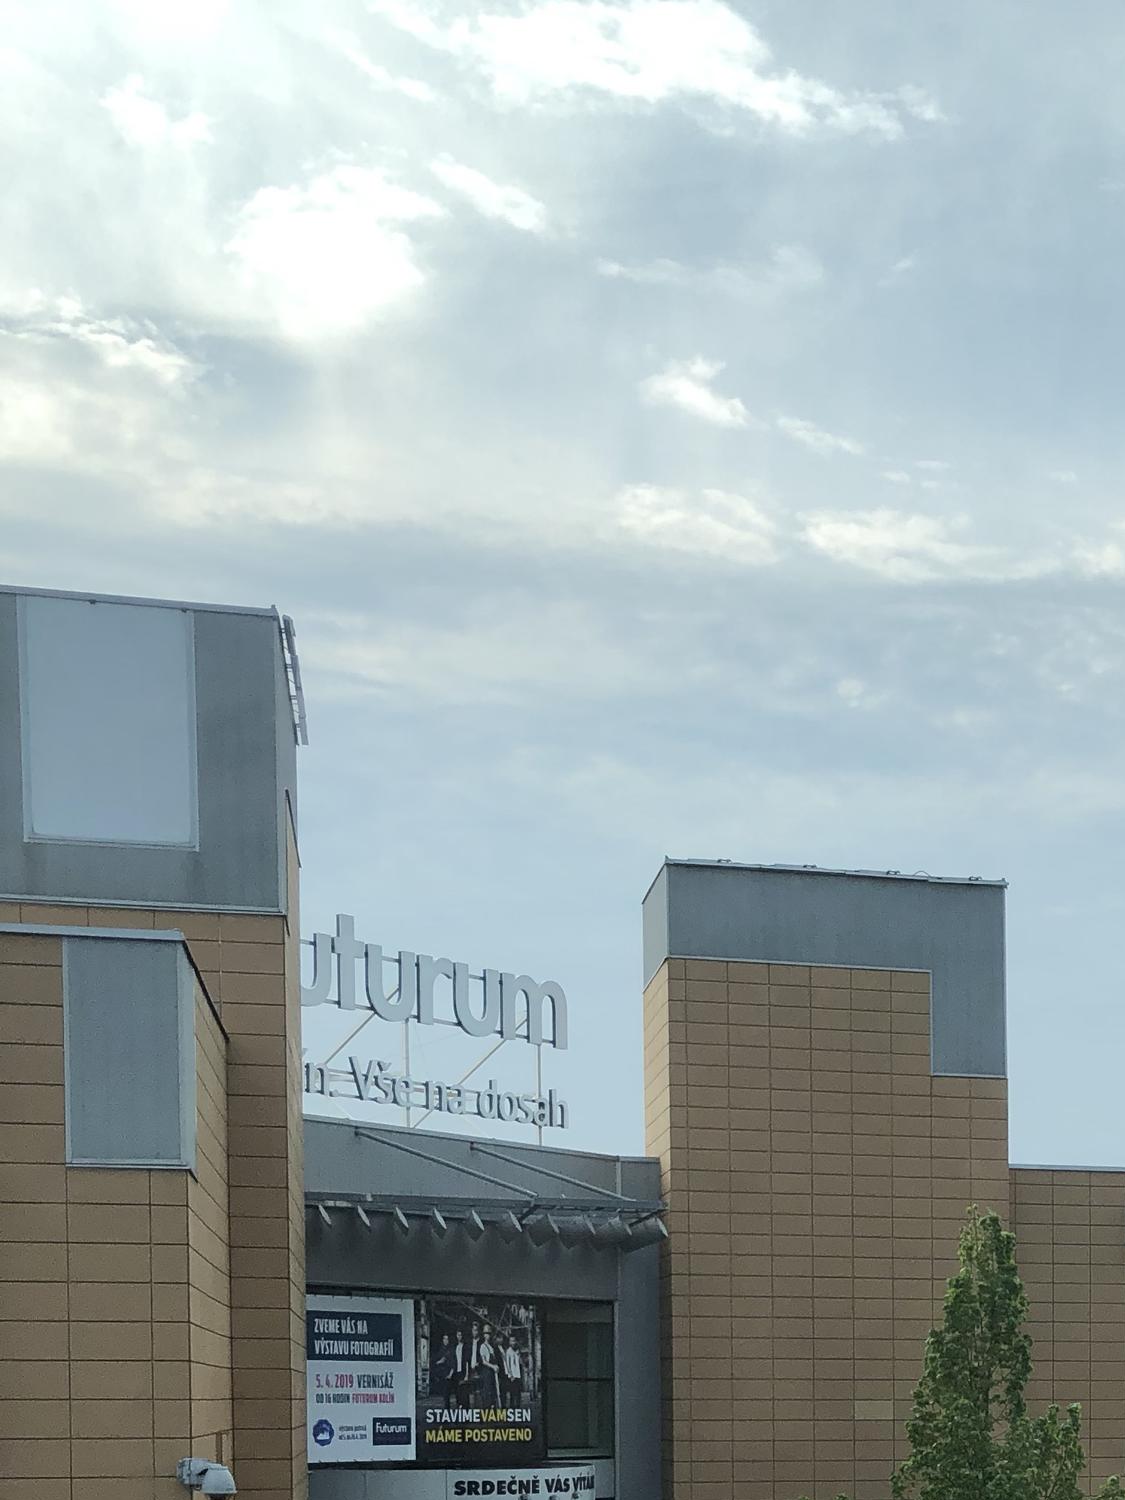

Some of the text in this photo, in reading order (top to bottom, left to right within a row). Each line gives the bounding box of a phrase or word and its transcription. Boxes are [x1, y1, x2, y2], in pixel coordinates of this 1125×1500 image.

[348, 1056, 416, 1107] Vše
[425, 1080, 466, 1114] na
[477, 1079, 569, 1129] dosah
[314, 1316, 369, 1335] ZVEME VÁS NA
[314, 1337, 349, 1355] VÝSTAVU
[334, 1373, 354, 1389] 2019
[357, 1371, 394, 1389] VERNISÁŽ
[375, 1422, 407, 1434] Futurum
[425, 1425, 532, 1443] MÁME POSTAVENO
[454, 1475, 540, 1496] SRDEČNĚ
[545, 1474, 571, 1493] VÁS
